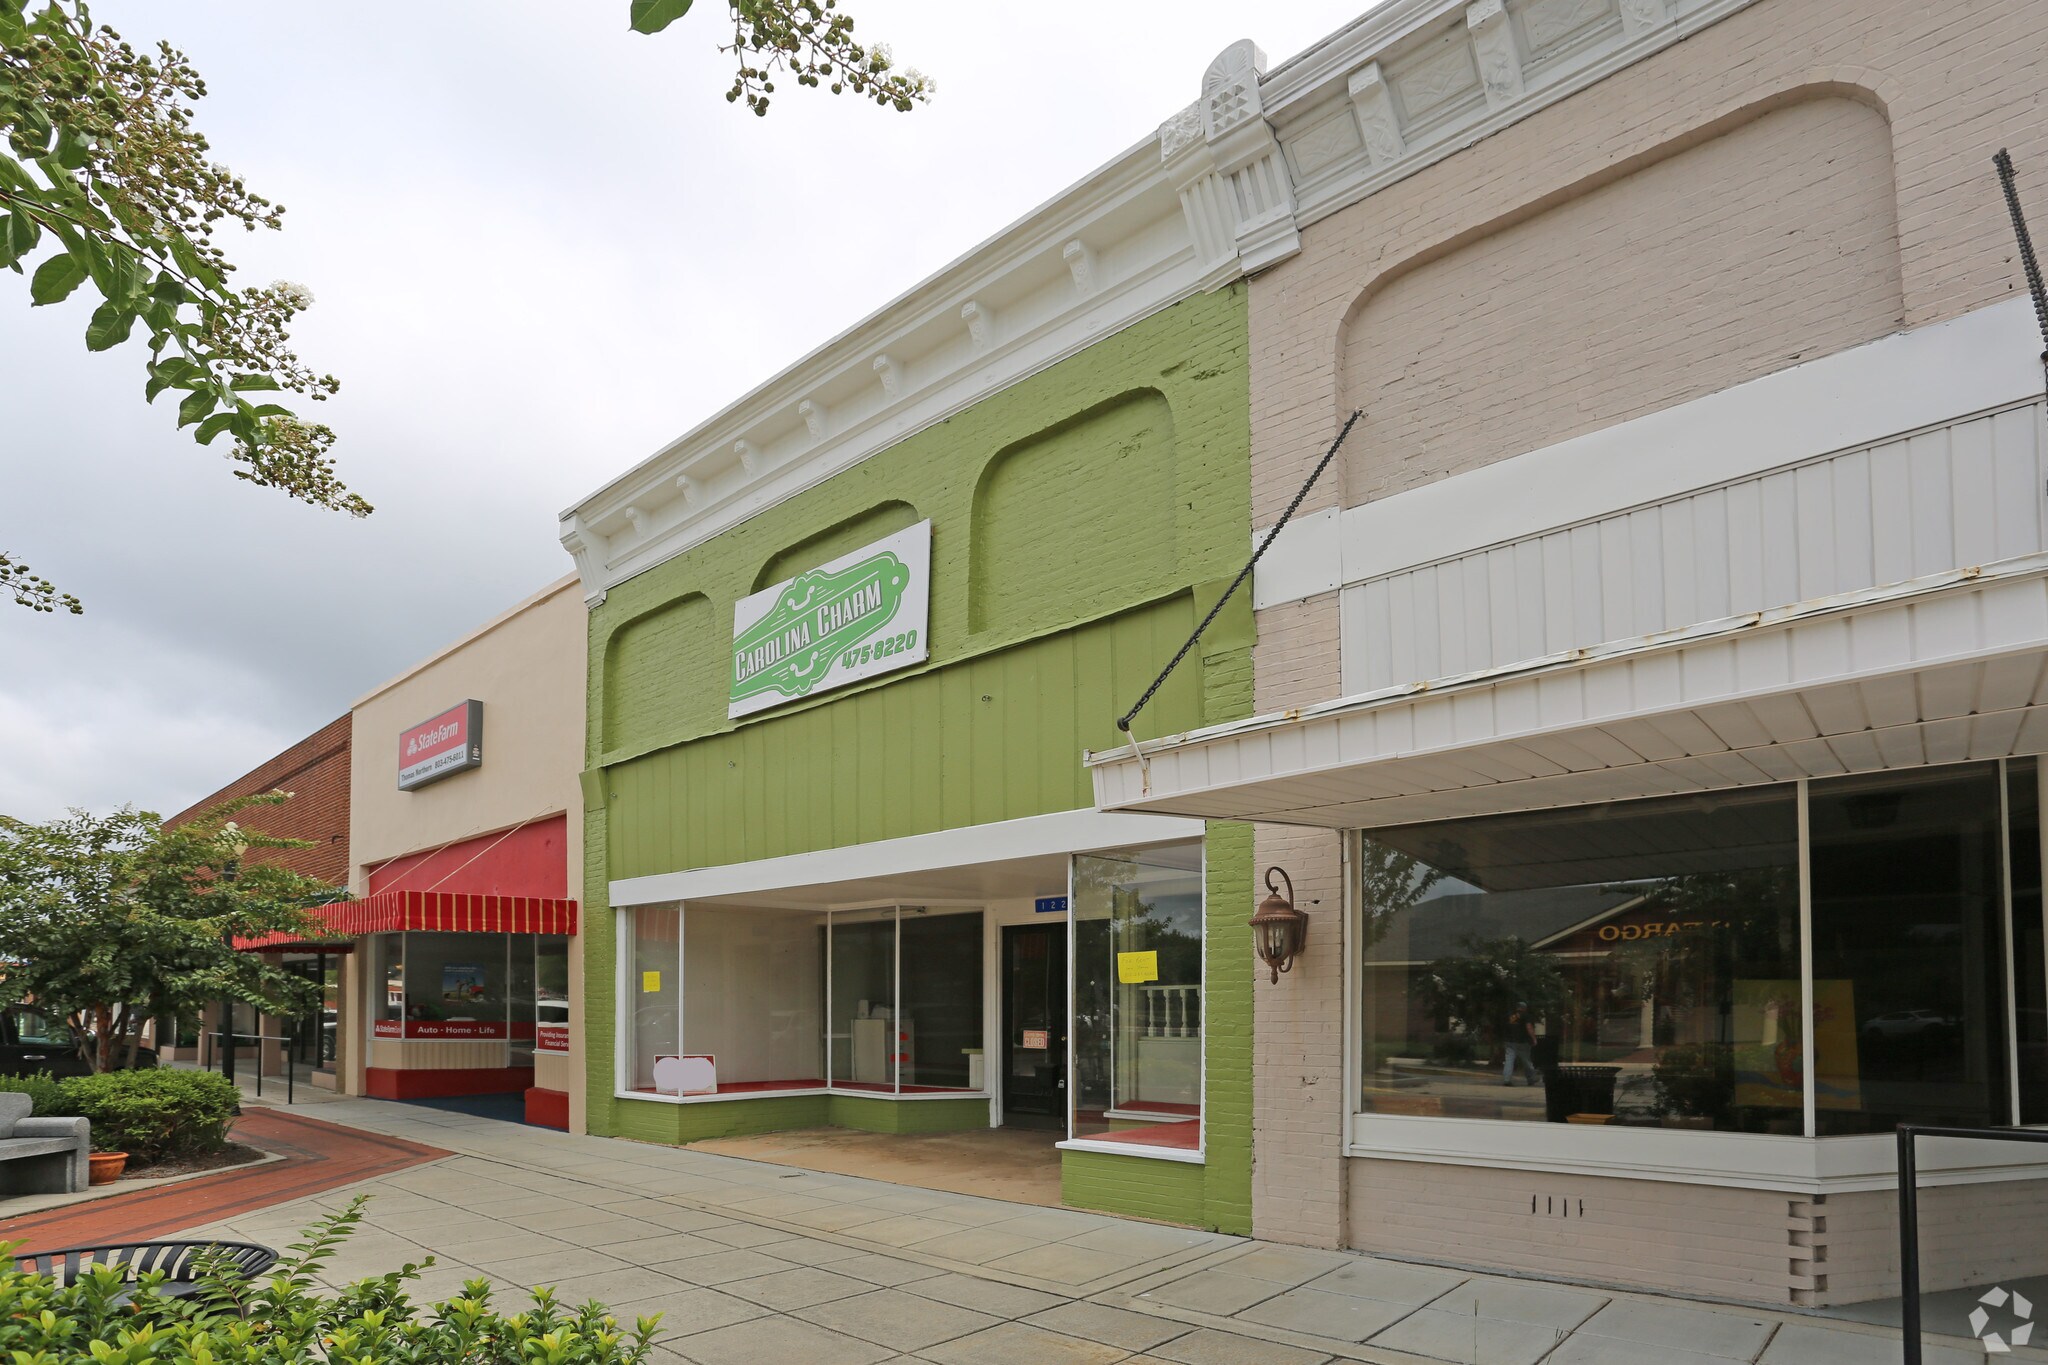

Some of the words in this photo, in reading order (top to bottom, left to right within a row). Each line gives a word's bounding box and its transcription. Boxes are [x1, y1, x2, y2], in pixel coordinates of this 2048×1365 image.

[736, 620, 811, 682] CAROLINA
[817, 579, 883, 638] CHARM
[401, 771, 415, 782] Thomas
[415, 764, 433, 777] Northern
[417, 1026, 439, 1034] Auto
[445, 1026, 472, 1034] Home
[479, 1026, 496, 1034] Life
[539, 1030, 556, 1039] Providing
[544, 1039, 561, 1047] Financial
